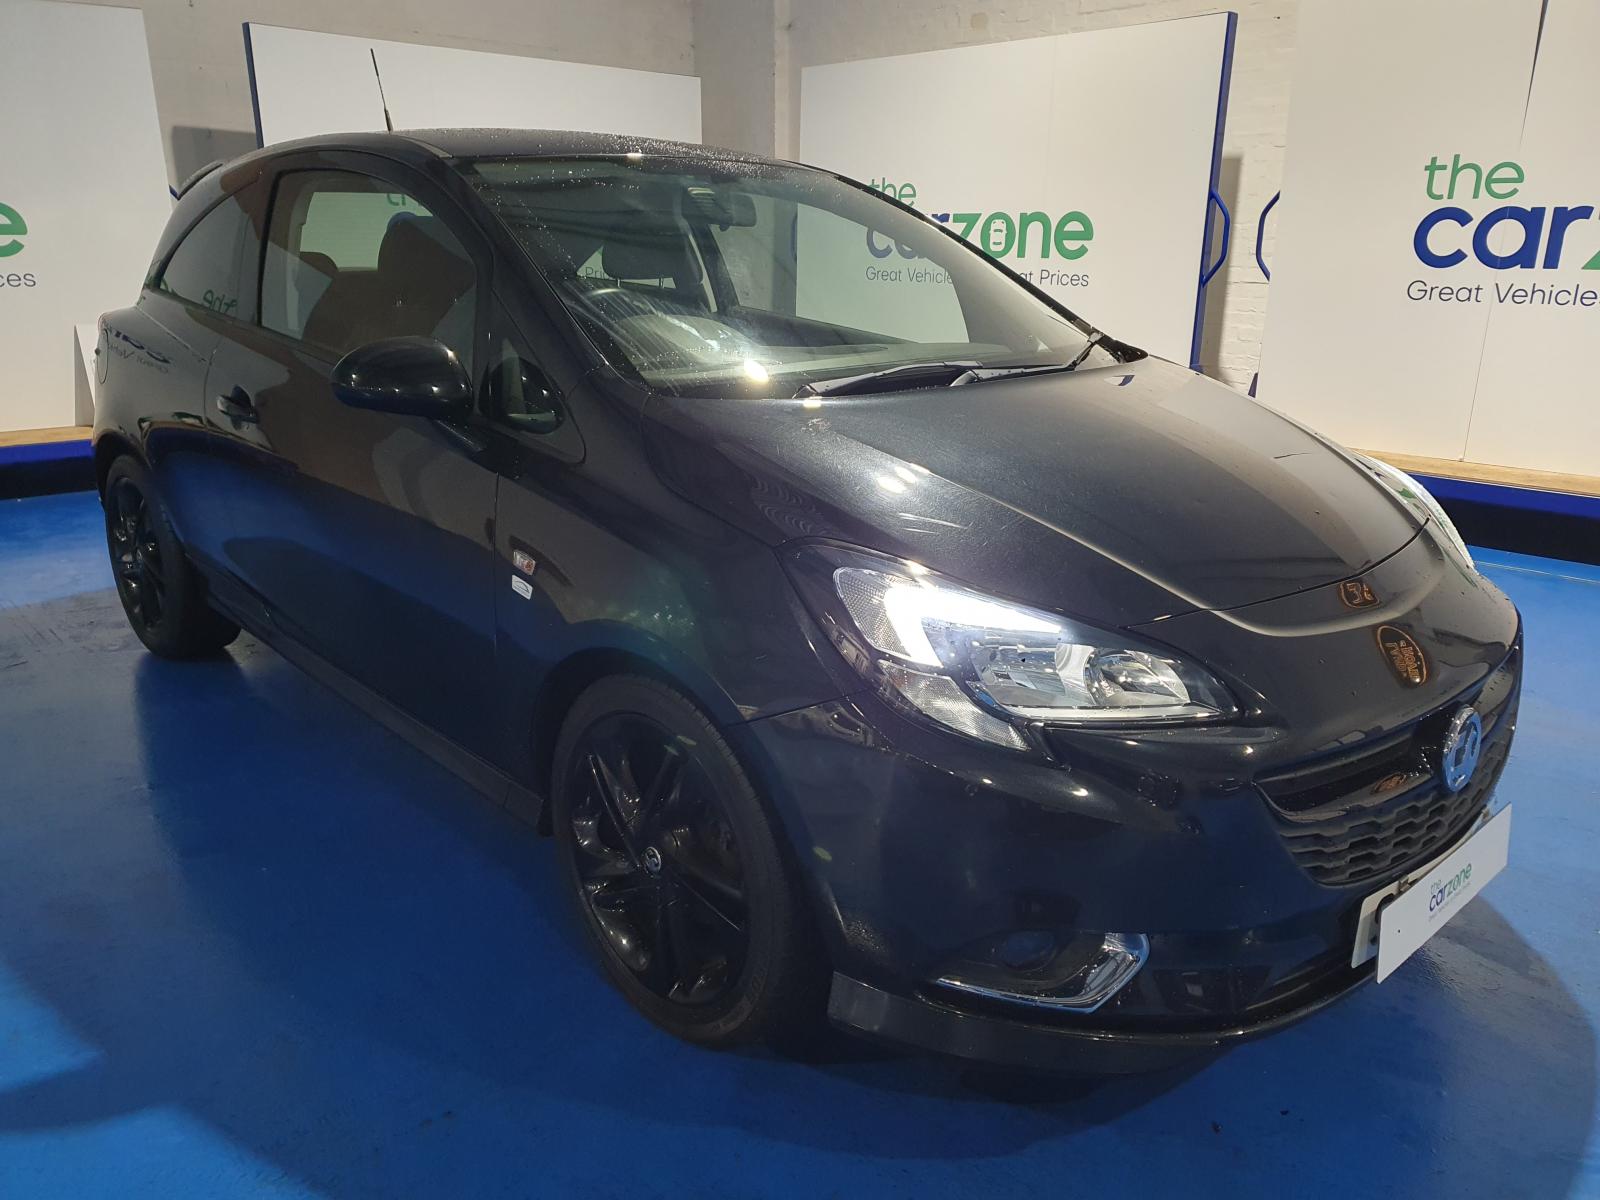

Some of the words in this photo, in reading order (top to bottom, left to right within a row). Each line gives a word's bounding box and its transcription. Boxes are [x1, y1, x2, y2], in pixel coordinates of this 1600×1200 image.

[1424, 154, 1525, 200] the
[866, 265, 901, 283] Great
[1039, 269, 1089, 287] Prices
[1407, 280, 1483, 302] Great
[1495, 283, 1600, 306] Vehicle
[1429, 863, 1472, 912] carzone
